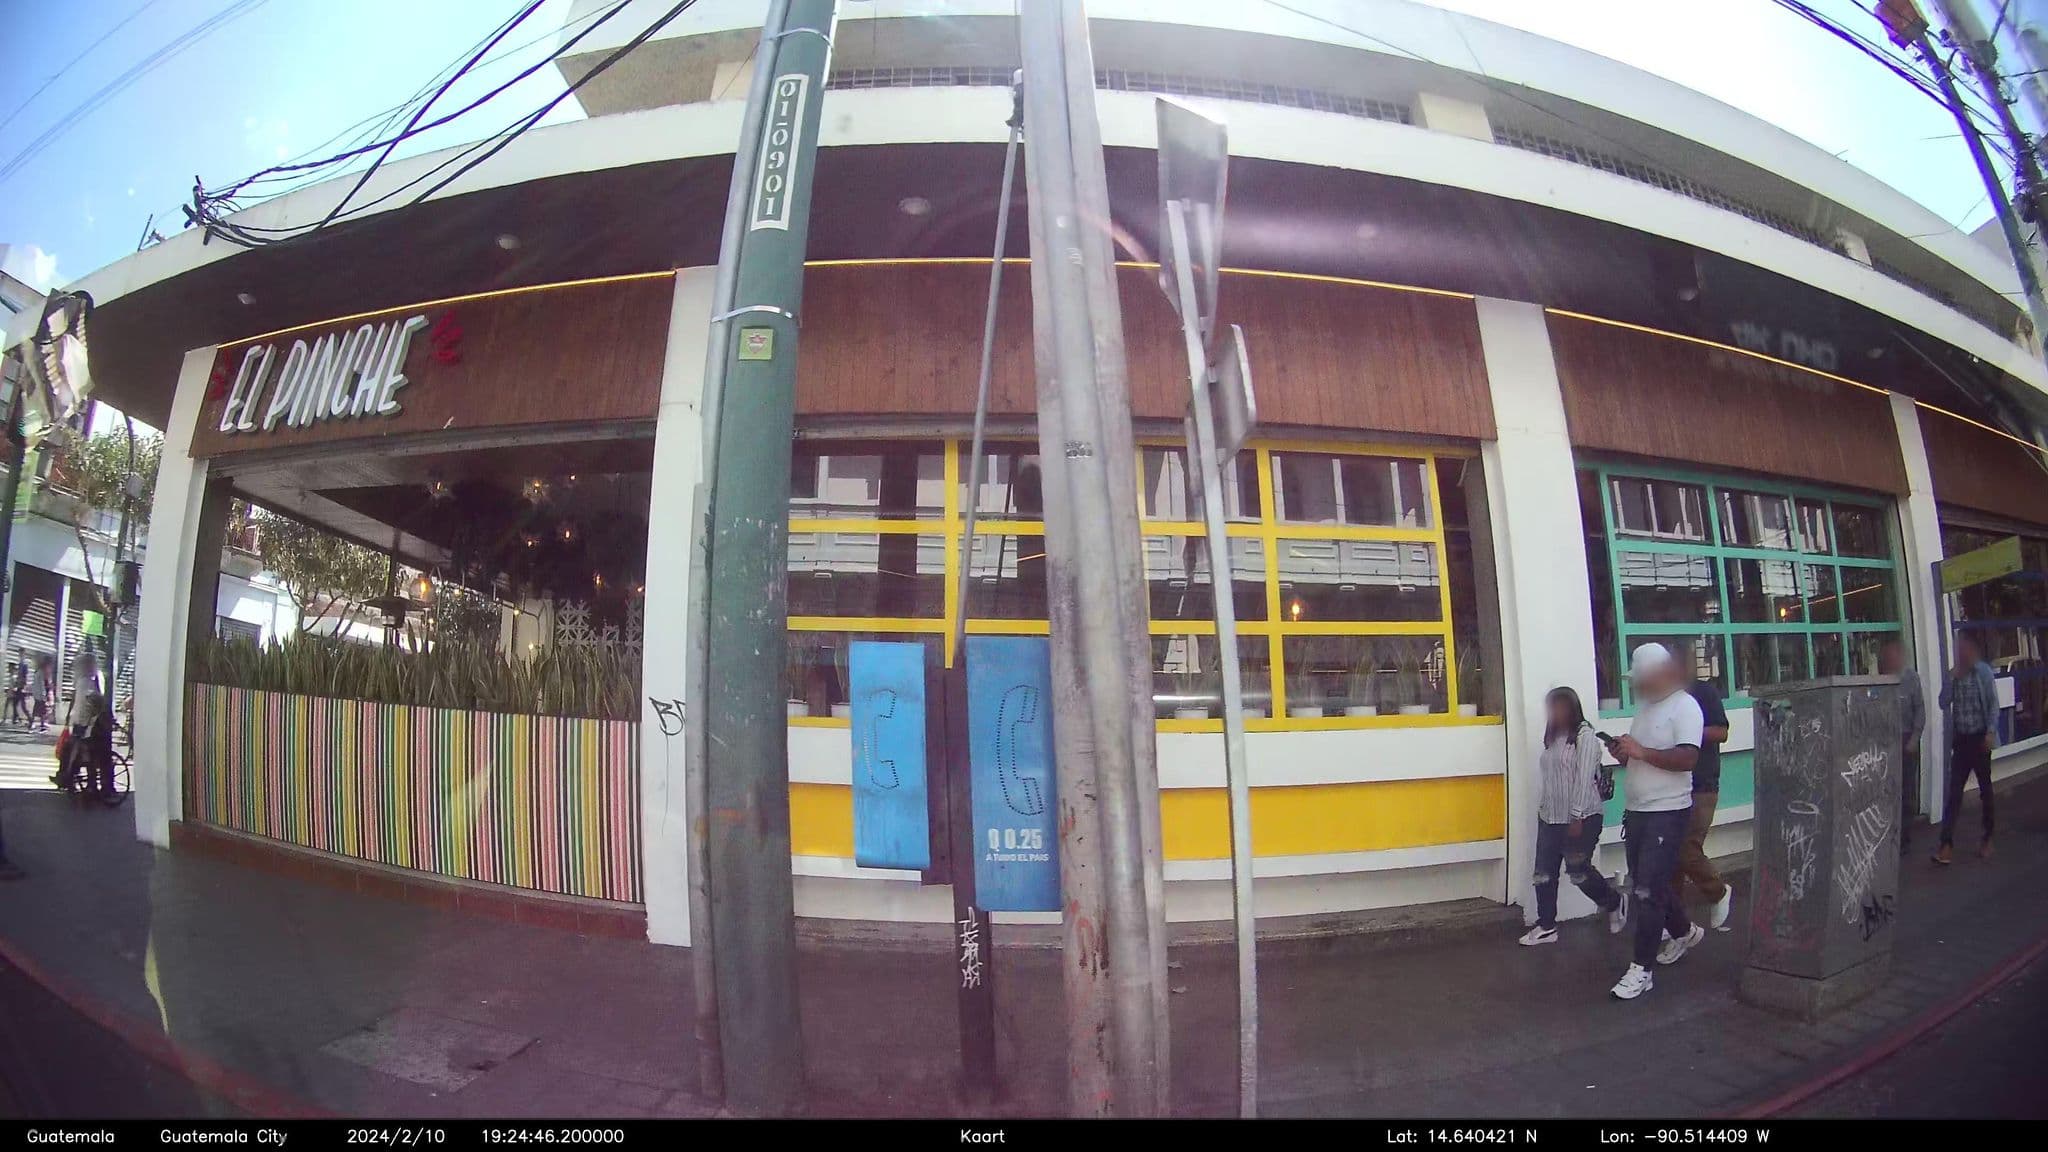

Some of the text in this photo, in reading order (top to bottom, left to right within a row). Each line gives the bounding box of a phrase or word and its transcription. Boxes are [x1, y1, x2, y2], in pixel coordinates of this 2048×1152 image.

[764, 80, 798, 216] 01-0901
[220, 315, 429, 432] EL PINCHE
[1004, 828, 1042, 850] 0.25
